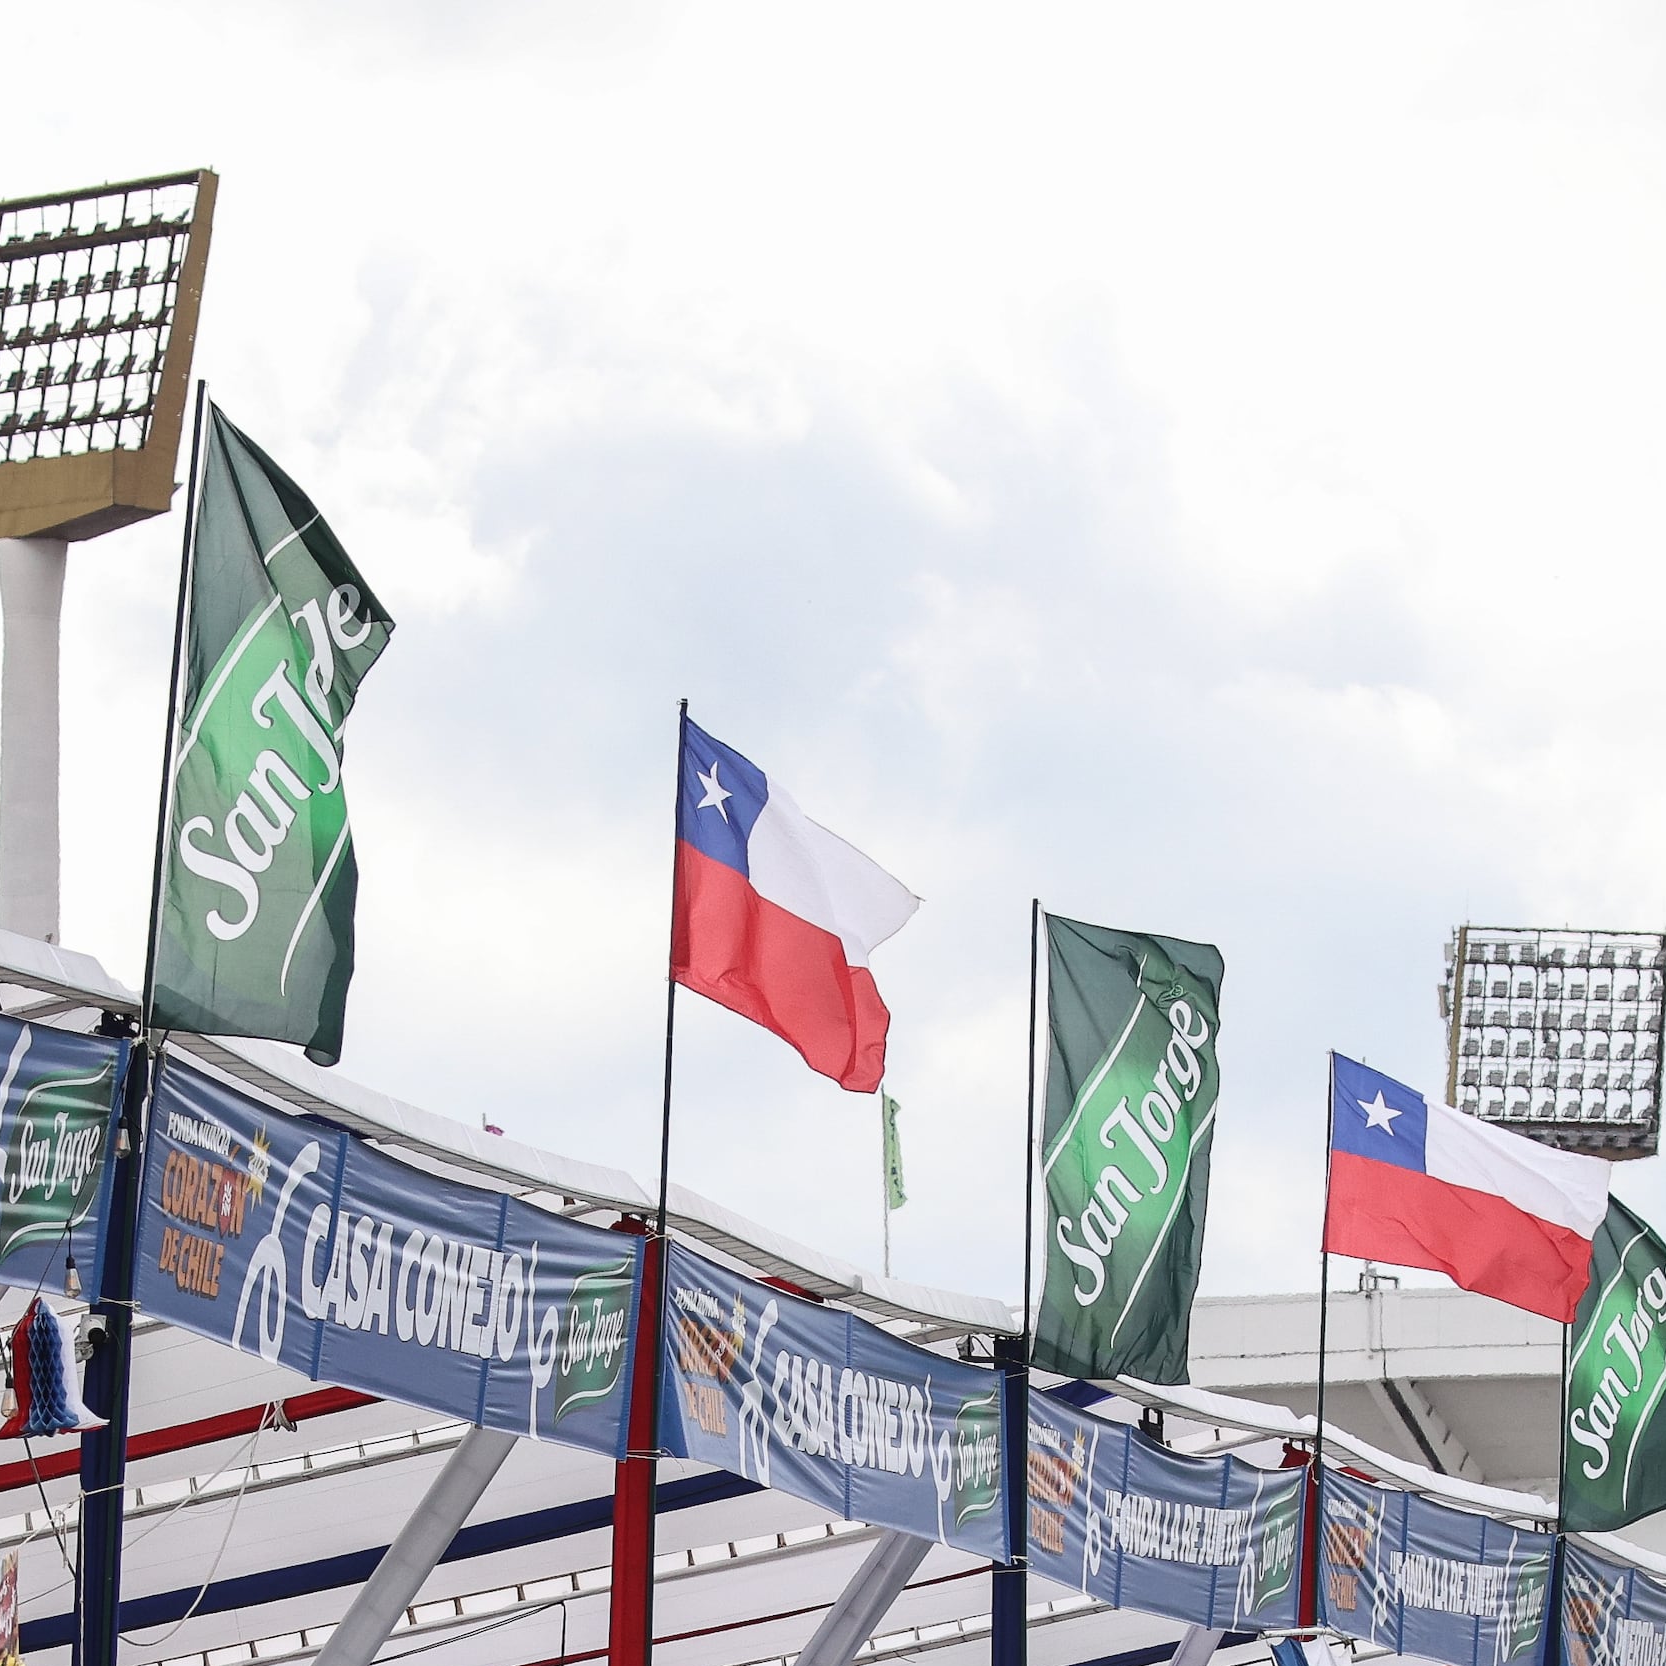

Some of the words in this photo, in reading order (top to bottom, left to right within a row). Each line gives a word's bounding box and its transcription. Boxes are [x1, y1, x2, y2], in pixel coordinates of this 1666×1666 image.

[179, 748, 314, 942] San
[167, 1110, 199, 1146] FONDA
[1099, 1000, 1210, 1194] Jorge
[9, 1118, 51, 1205] San
[44, 1111, 102, 1201] Jorge
[159, 1226, 181, 1274] DE
[176, 1232, 226, 1300] CHILE
[301, 1202, 396, 1334] CASA
[396, 1229, 525, 1363] CONEJO
[1056, 1165, 1145, 1307] San
[560, 1306, 595, 1379] San
[587, 1291, 626, 1377] Jorge
[771, 1350, 836, 1462] CASA
[836, 1368, 930, 1479] CONEJO
[955, 1427, 981, 1492] San
[973, 1411, 999, 1493] Jorge
[1570, 1366, 1631, 1480] San
[1161, 1500, 1182, 1562] LA
[1259, 1525, 1276, 1582] San
[1273, 1518, 1296, 1577] Jorge
